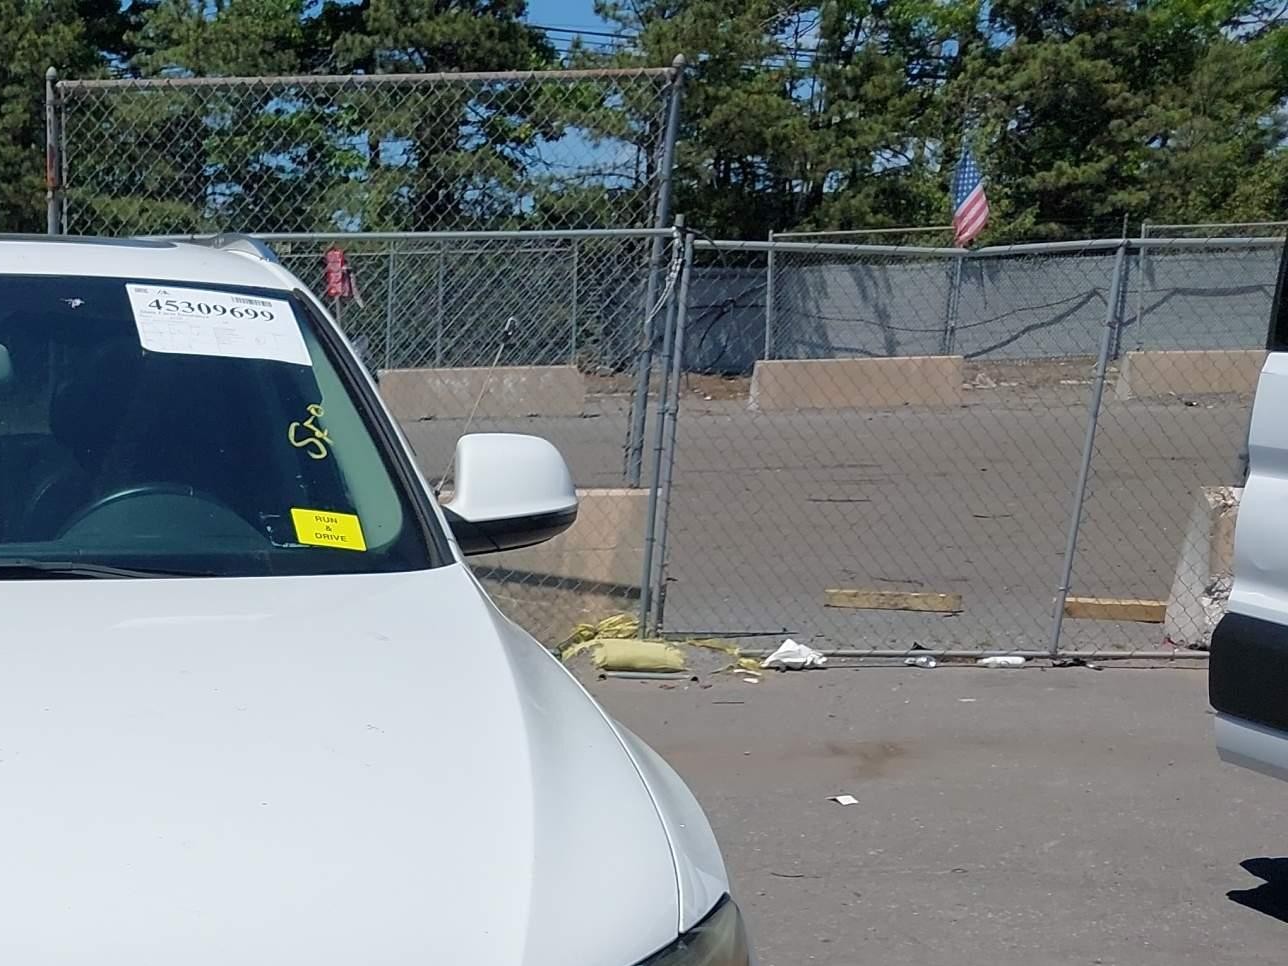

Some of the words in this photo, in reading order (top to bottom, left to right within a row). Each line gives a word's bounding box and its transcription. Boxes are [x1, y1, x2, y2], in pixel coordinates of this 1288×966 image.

[148, 299, 275, 321] 45309699
[314, 515, 338, 524] RUN
[314, 532, 348, 542] DRIVE
